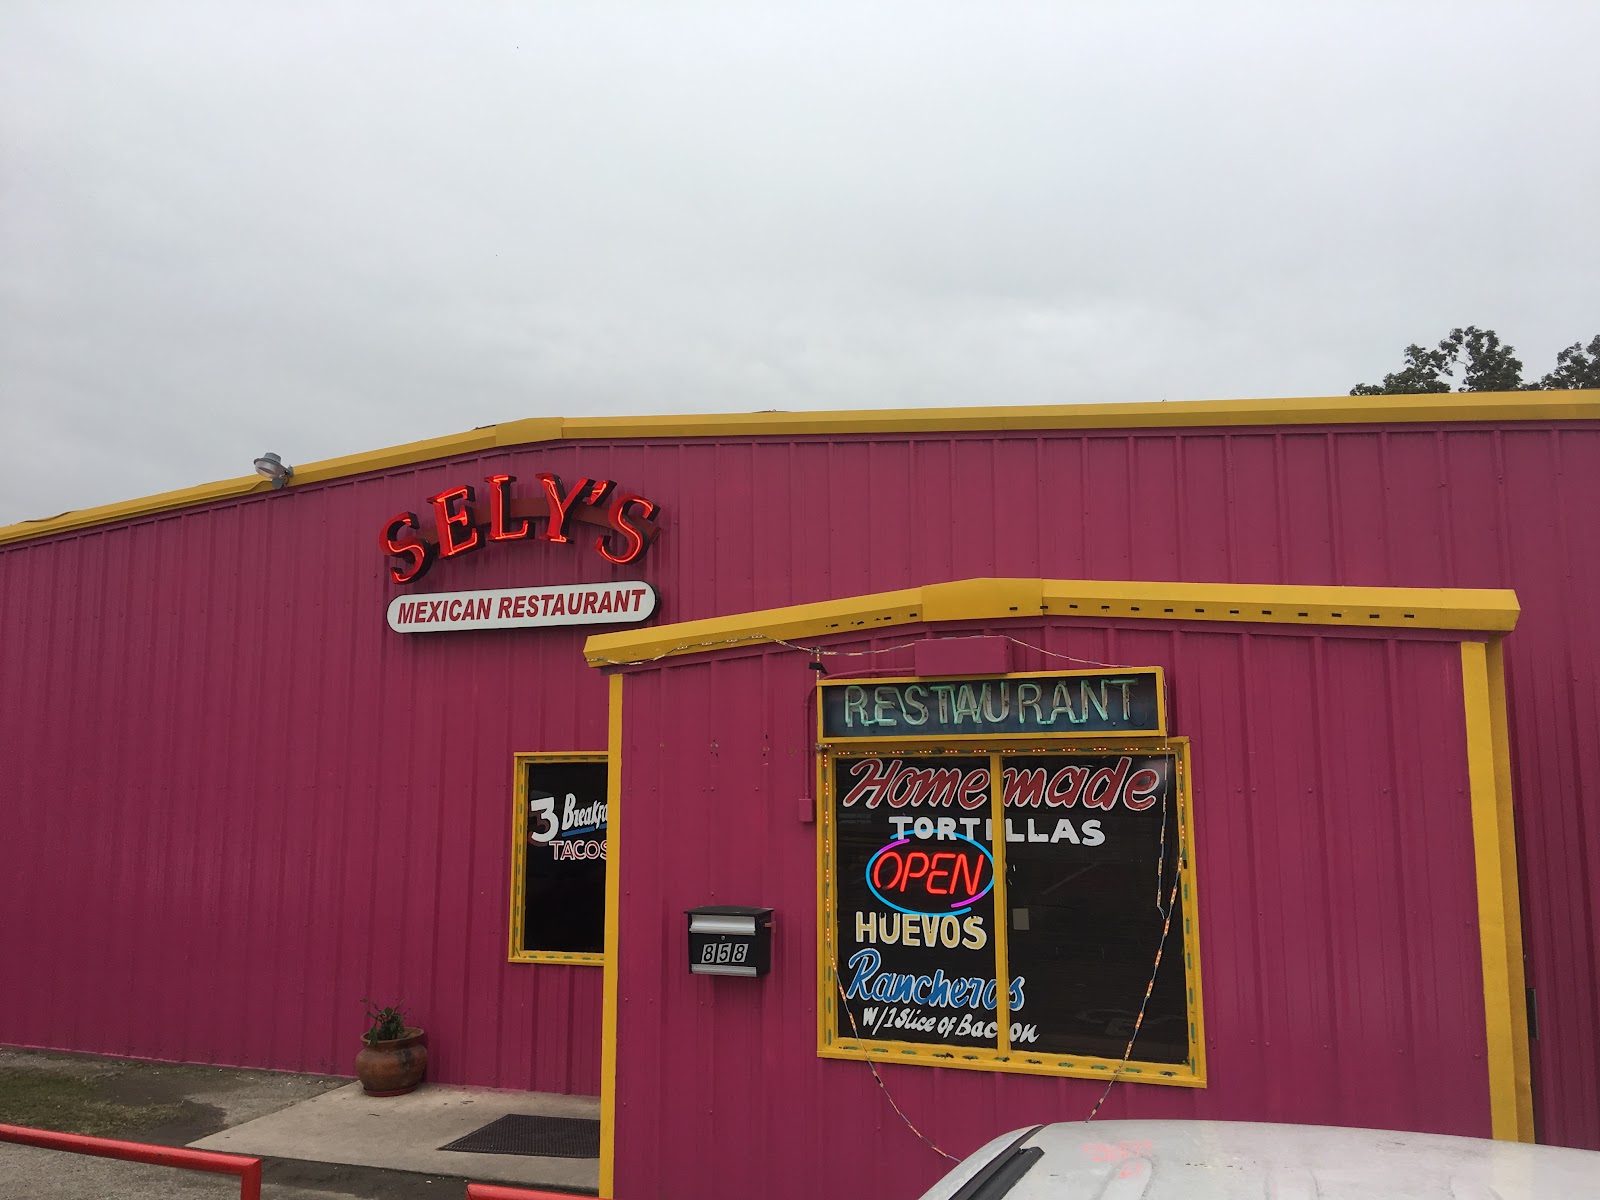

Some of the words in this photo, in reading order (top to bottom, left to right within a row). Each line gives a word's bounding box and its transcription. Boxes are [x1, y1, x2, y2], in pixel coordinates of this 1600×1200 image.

[378, 472, 661, 584] SELY'S
[397, 598, 493, 625] MEXICAN
[499, 589, 647, 619] RESTAURANT
[844, 678, 1140, 727] RESTAURANT
[530, 796, 559, 843] 3
[561, 792, 607, 831] Breakfa
[888, 816, 1106, 847] TORTILLAS
[548, 839, 607, 860] TACOS
[872, 851, 985, 896] OPEN
[855, 911, 987, 950] HUEVOS
[700, 943, 749, 964] 858
[847, 947, 1026, 1011] Rancheros
[937, 1015, 955, 1038] of
[954, 1013, 1041, 1043] Bacon
